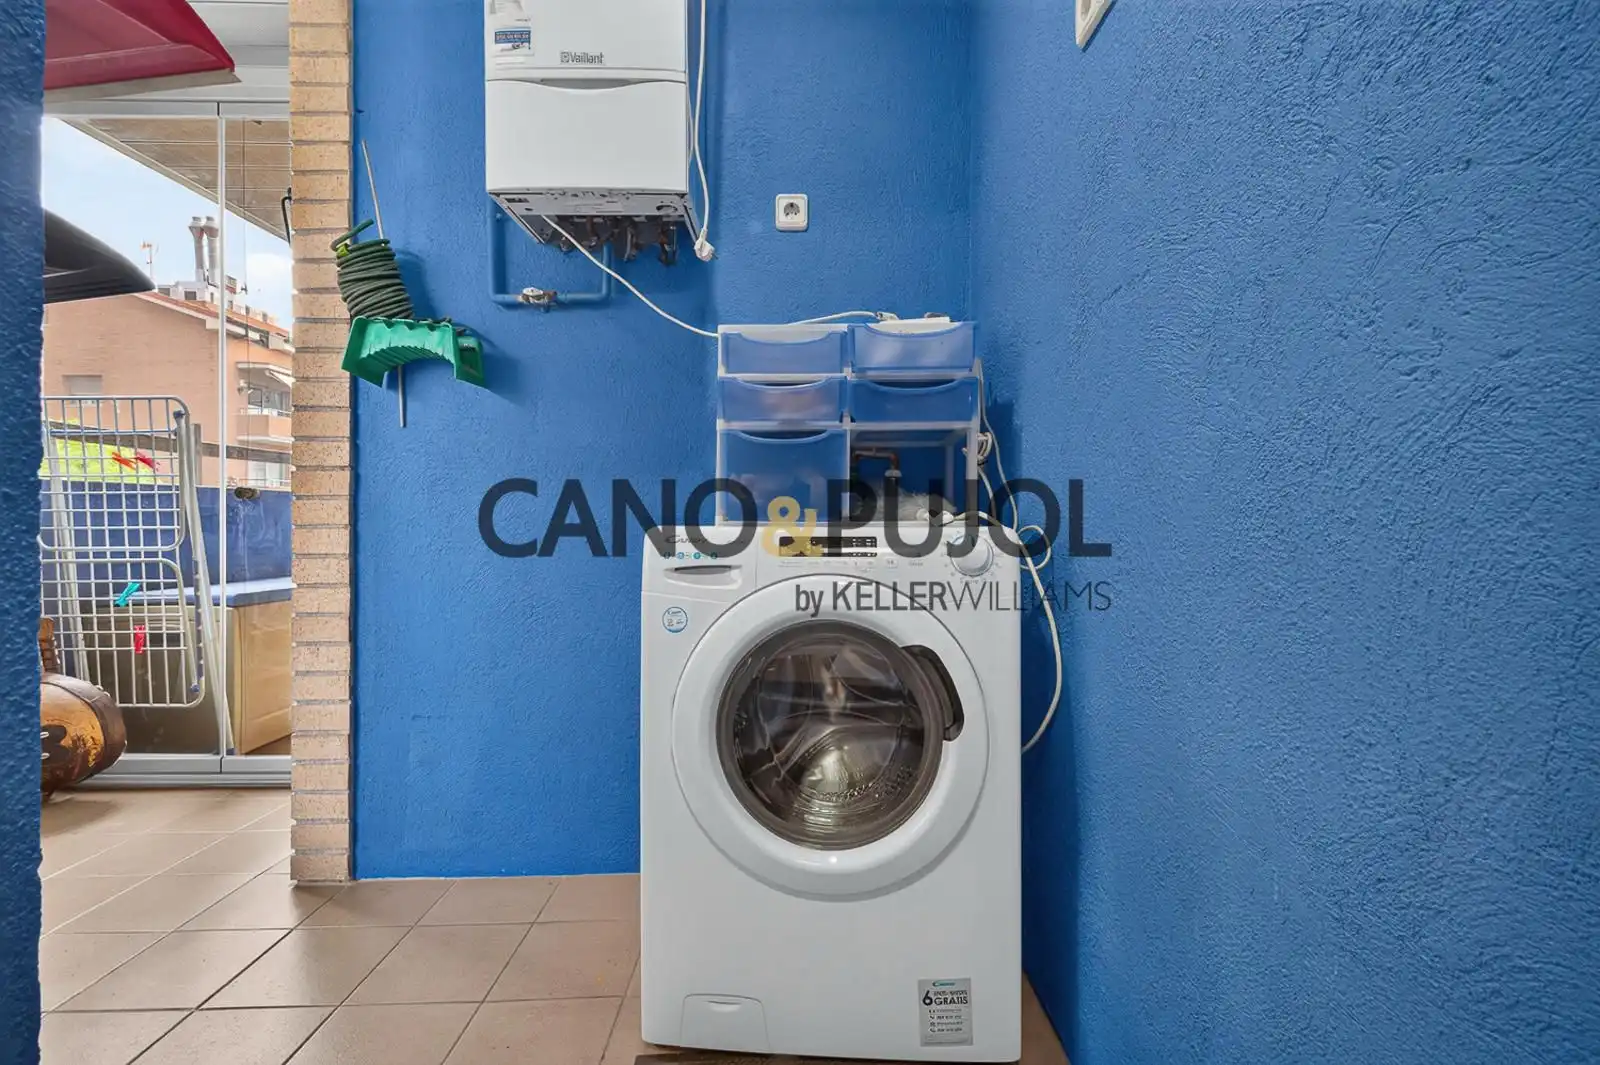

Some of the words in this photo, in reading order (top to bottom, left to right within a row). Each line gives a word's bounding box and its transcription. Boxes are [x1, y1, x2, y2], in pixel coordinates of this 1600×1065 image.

[569, 52, 604, 64] Vaillant
[922, 990, 933, 1006] 6
[934, 997, 968, 1006] GRATIS
